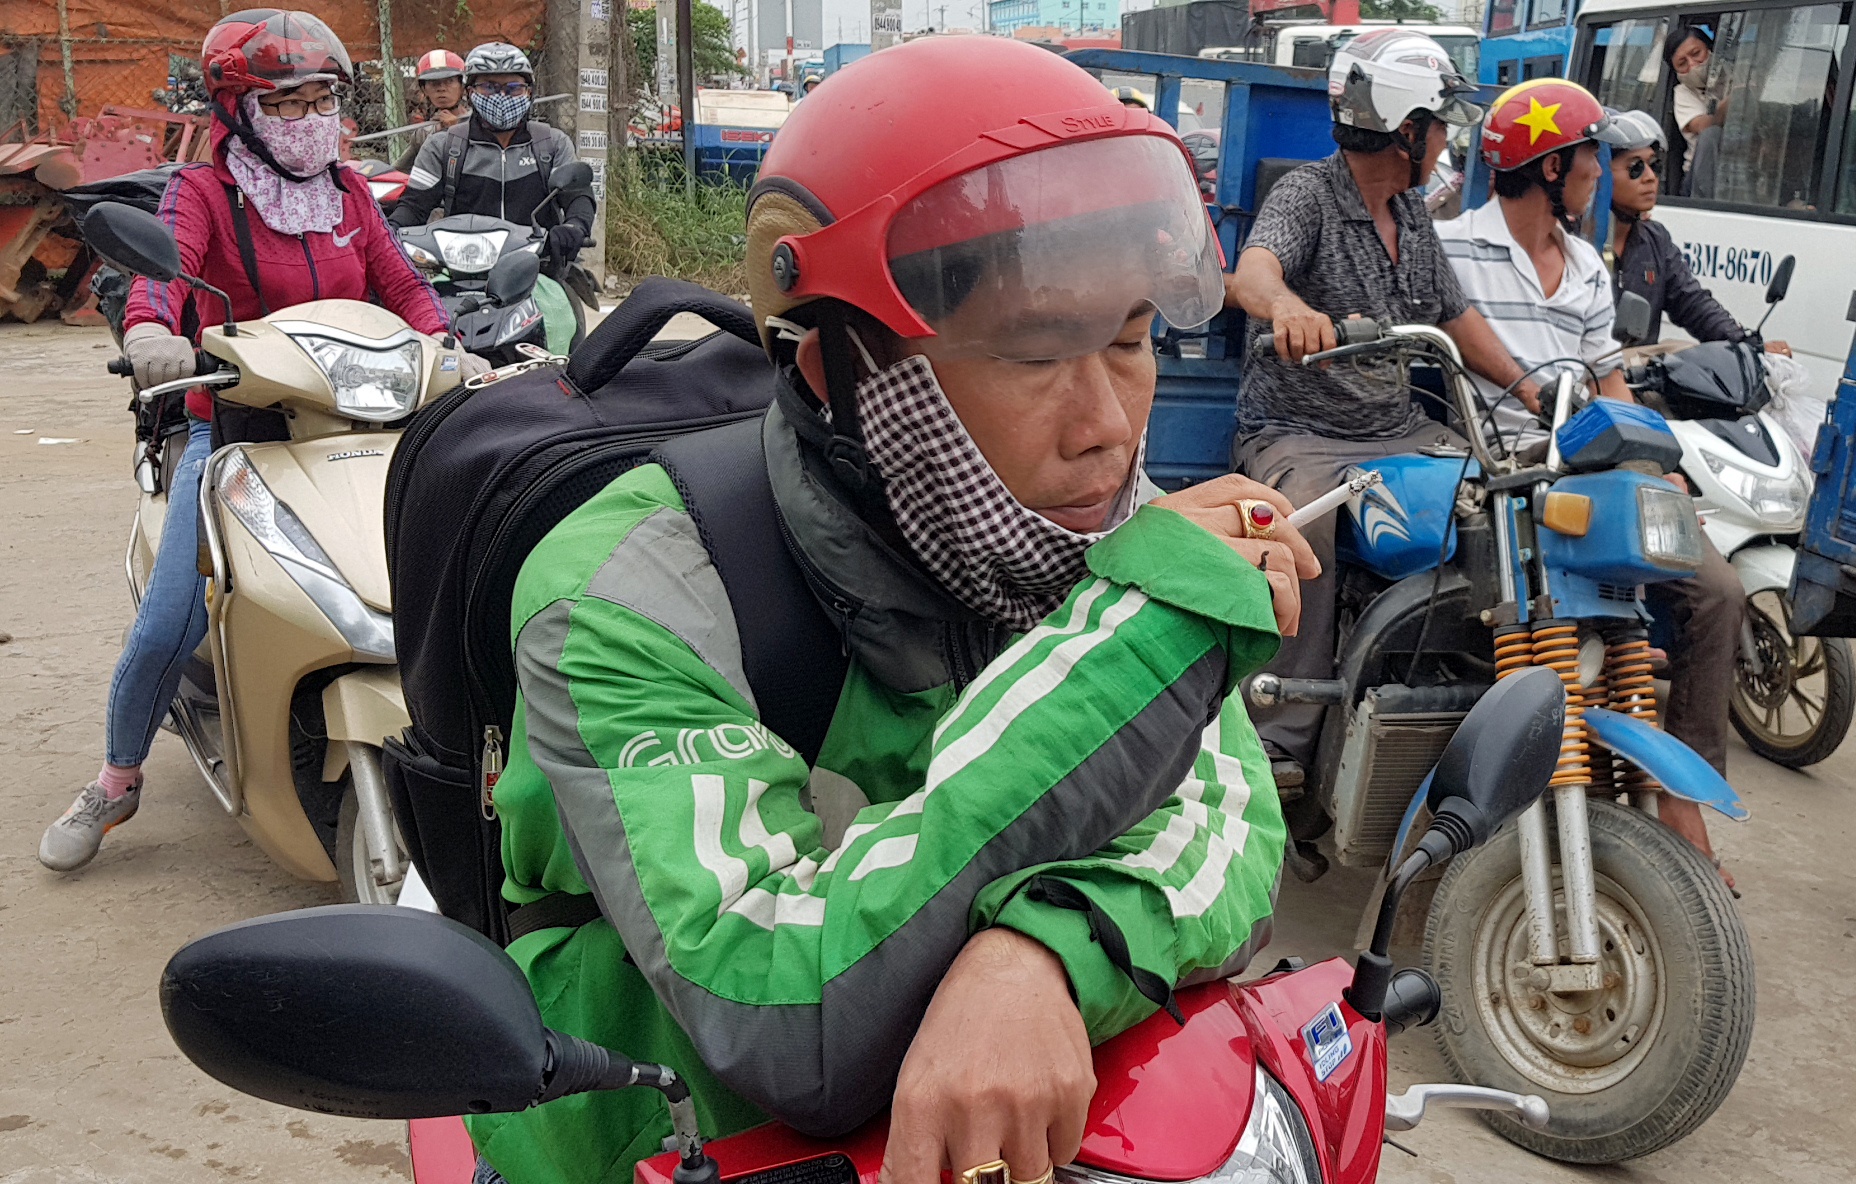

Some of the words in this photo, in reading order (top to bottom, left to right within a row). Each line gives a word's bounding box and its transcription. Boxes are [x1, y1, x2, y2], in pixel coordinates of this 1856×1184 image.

[1061, 115, 1115, 132] STYLE
[721, 129, 774, 143] ISEKI
[1682, 242, 1773, 287] 53M-8670
[327, 449, 385, 461] HONDA
[1310, 1008, 1339, 1045] FI
